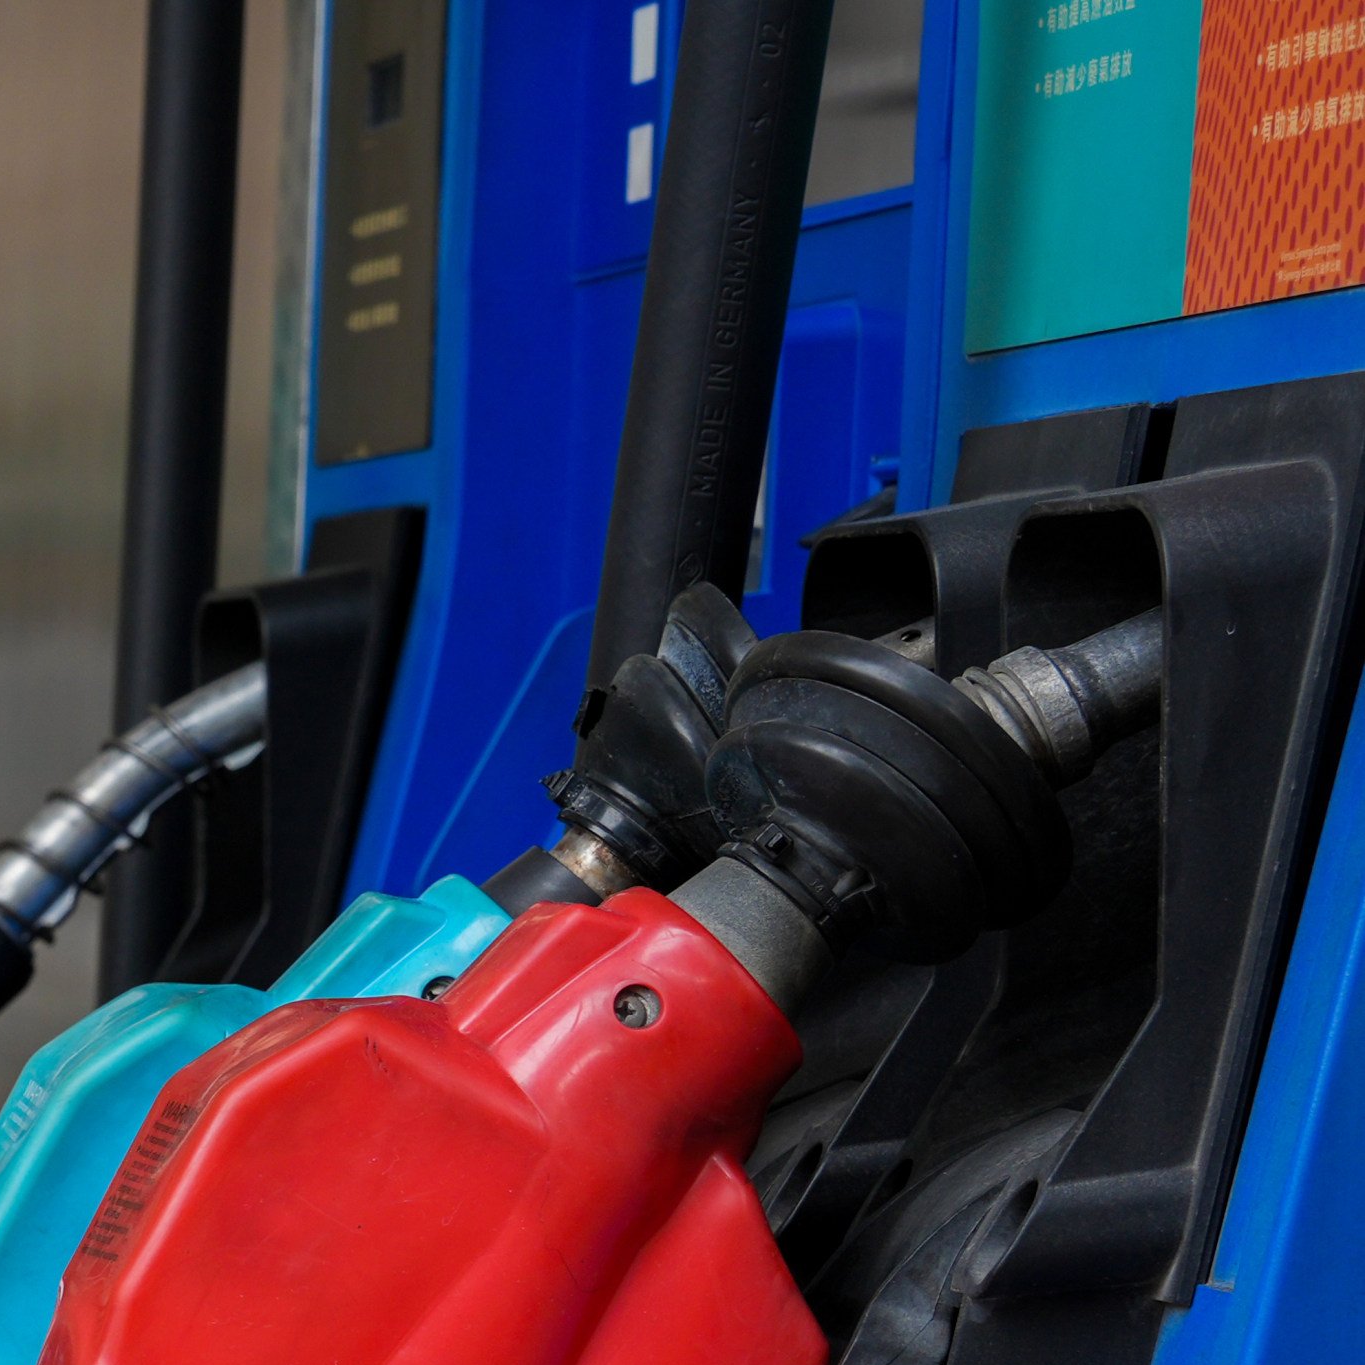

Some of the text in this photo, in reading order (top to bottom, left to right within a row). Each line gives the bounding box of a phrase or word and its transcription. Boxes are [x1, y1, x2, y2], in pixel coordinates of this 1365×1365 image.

[691, 194, 762, 499] MADE IN GERMANY
